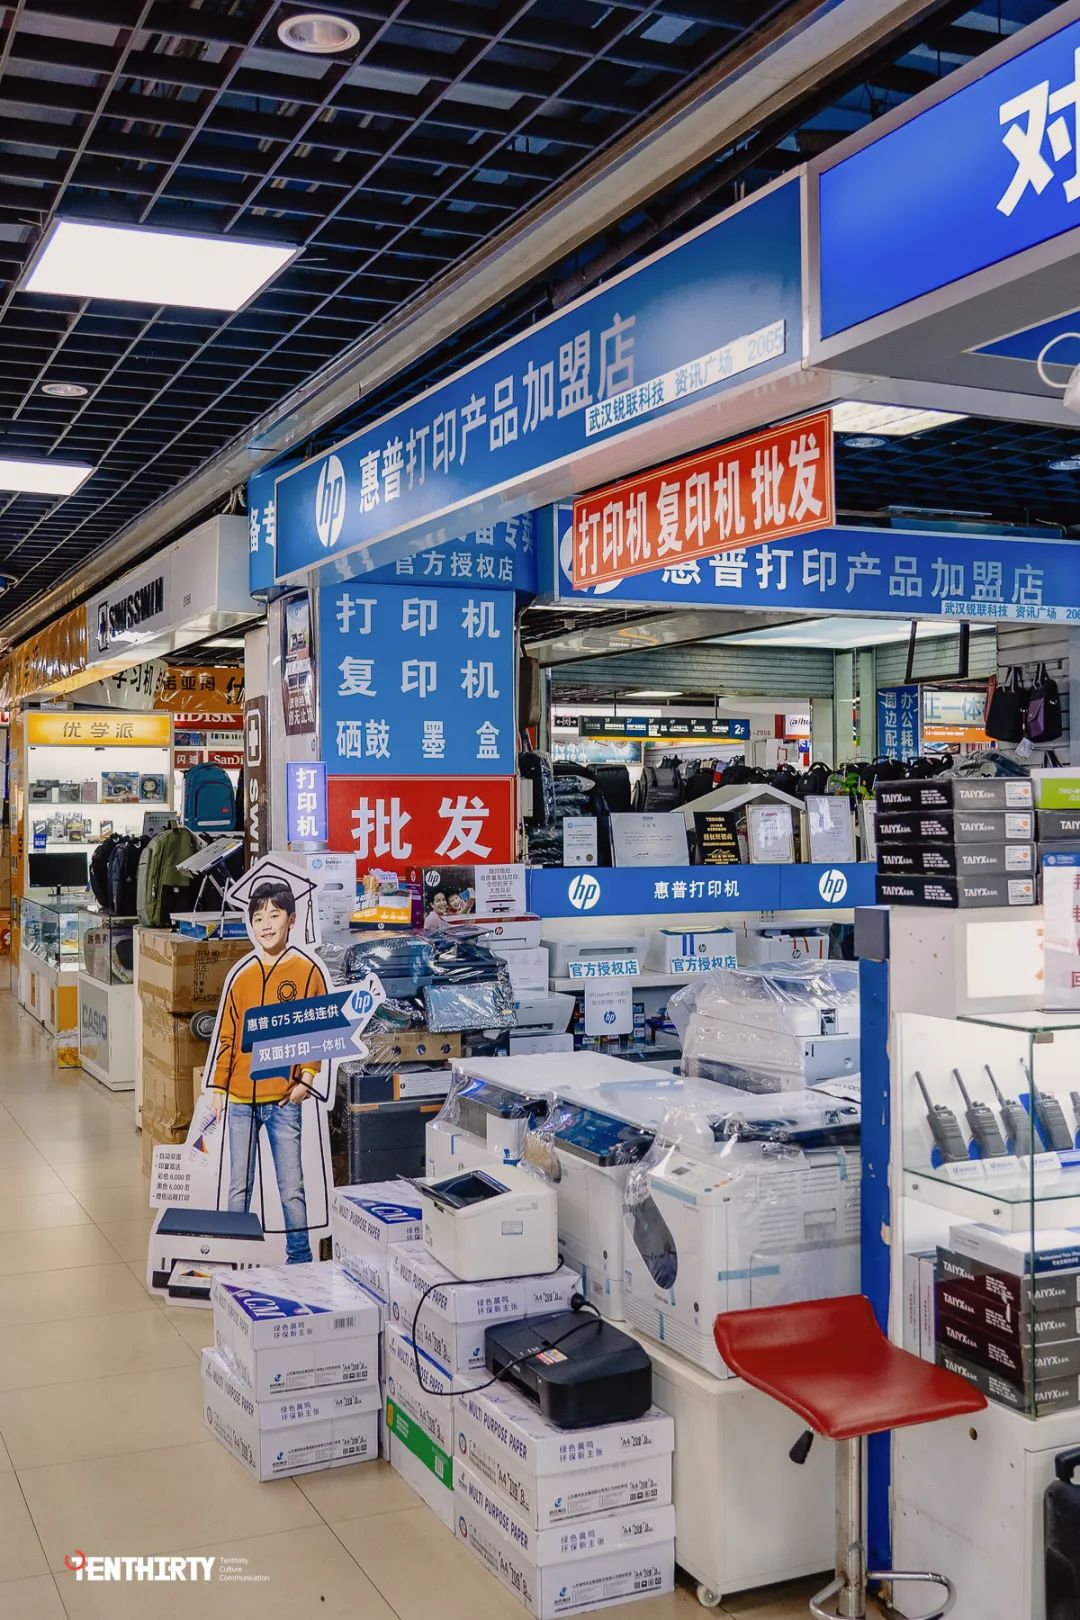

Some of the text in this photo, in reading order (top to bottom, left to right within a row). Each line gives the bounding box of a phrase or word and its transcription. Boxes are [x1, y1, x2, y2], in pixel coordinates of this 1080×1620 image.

[588, 326, 784, 432] 武汉锐联科技 资讯广场 2065
[359, 312, 637, 514] 惠普打印产品加盟店
[316, 455, 346, 548] hp
[578, 433, 823, 577] 打印机 复印机 批发
[396, 551, 513, 582] 官方授权店
[336, 593, 500, 639] 打印机
[944, 602, 1009, 617] 武汉锐联科技
[1015, 605, 1057, 620] 资讯广场
[337, 655, 500, 699] 复印机
[63, 721, 134, 739] 优学派
[734, 724, 745, 735] 2F
[295, 768, 319, 837] 打印机
[351, 795, 493, 860] 批发
[426, 870, 441, 887] hp
[568, 874, 600, 910] hp
[654, 879, 739, 899] 惠普打印机
[819, 869, 847, 903] hp
[570, 959, 638, 977] 官方授权店
[672, 955, 737, 972] 官方授权店
[247, 1003, 340, 1032] 惠普 675 无线连供
[351, 990, 374, 1014] hp
[82, 1004, 109, 1041] CASIO
[259, 1037, 347, 1062] 双面打印一体机
[468, 1400, 527, 1461] MULTI PURPOSE PAPER
[468, 1481, 484, 1508] MULTI
[484, 1497, 509, 1532] PURPOSE
[510, 1521, 529, 1551] PAPER
